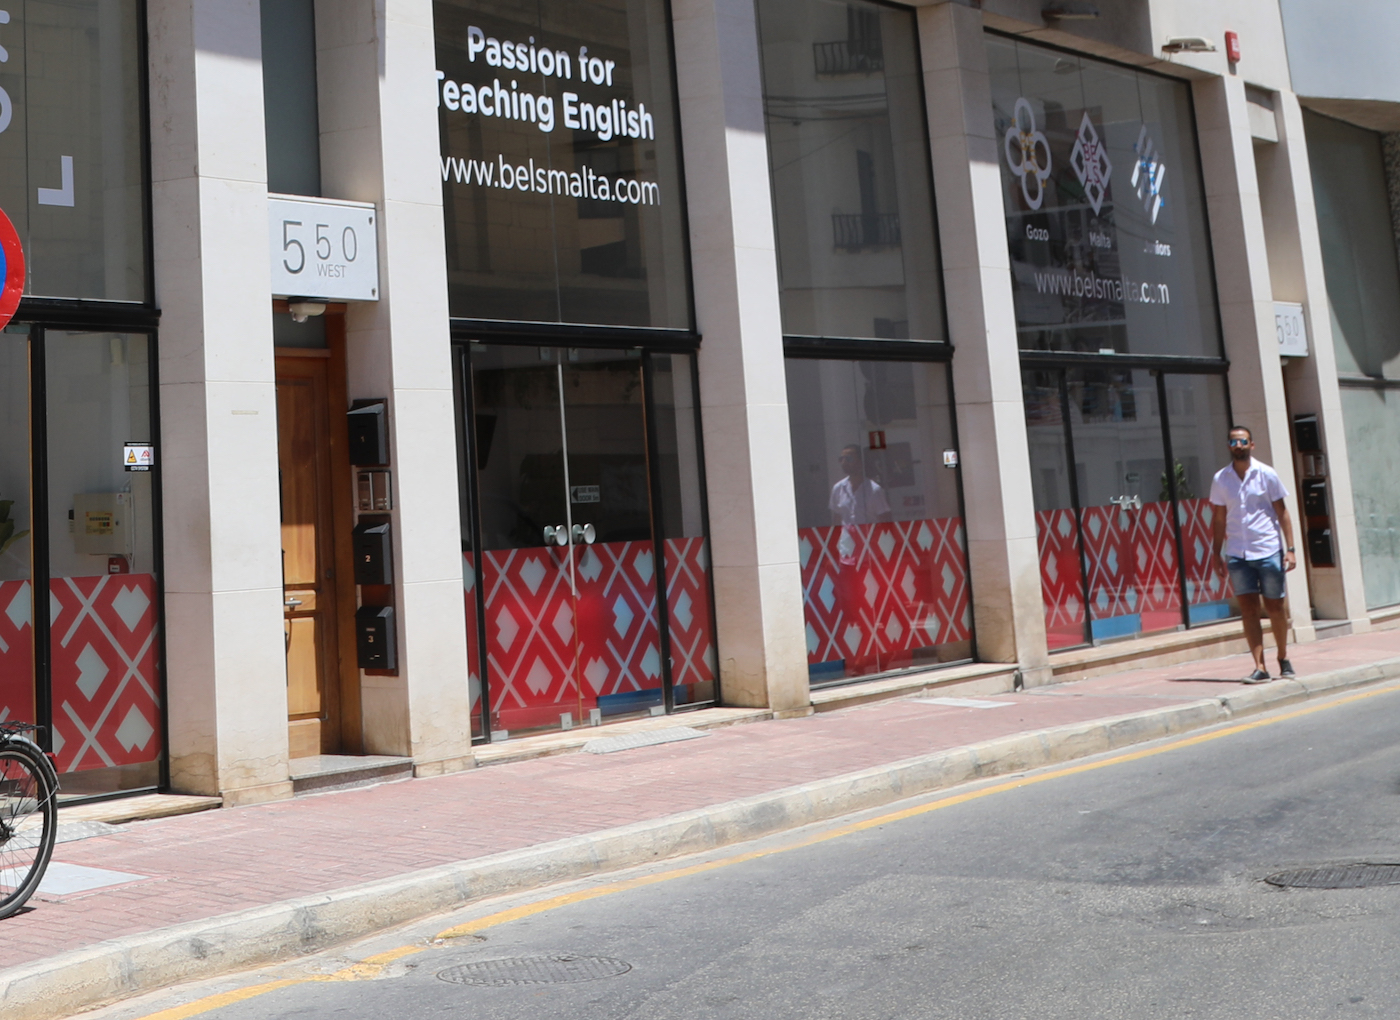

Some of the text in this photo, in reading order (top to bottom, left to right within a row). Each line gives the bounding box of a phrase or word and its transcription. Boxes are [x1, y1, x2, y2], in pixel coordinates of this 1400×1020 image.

[467, 25, 615, 87] Passion for
[562, 91, 654, 141] English
[1026, 223, 1049, 242] Gozo
[1089, 231, 1112, 249] Malta
[1143, 239, 1171, 257] iors
[317, 263, 346, 278] WEST
[1034, 269, 1170, 305] www.belsmalta.com
